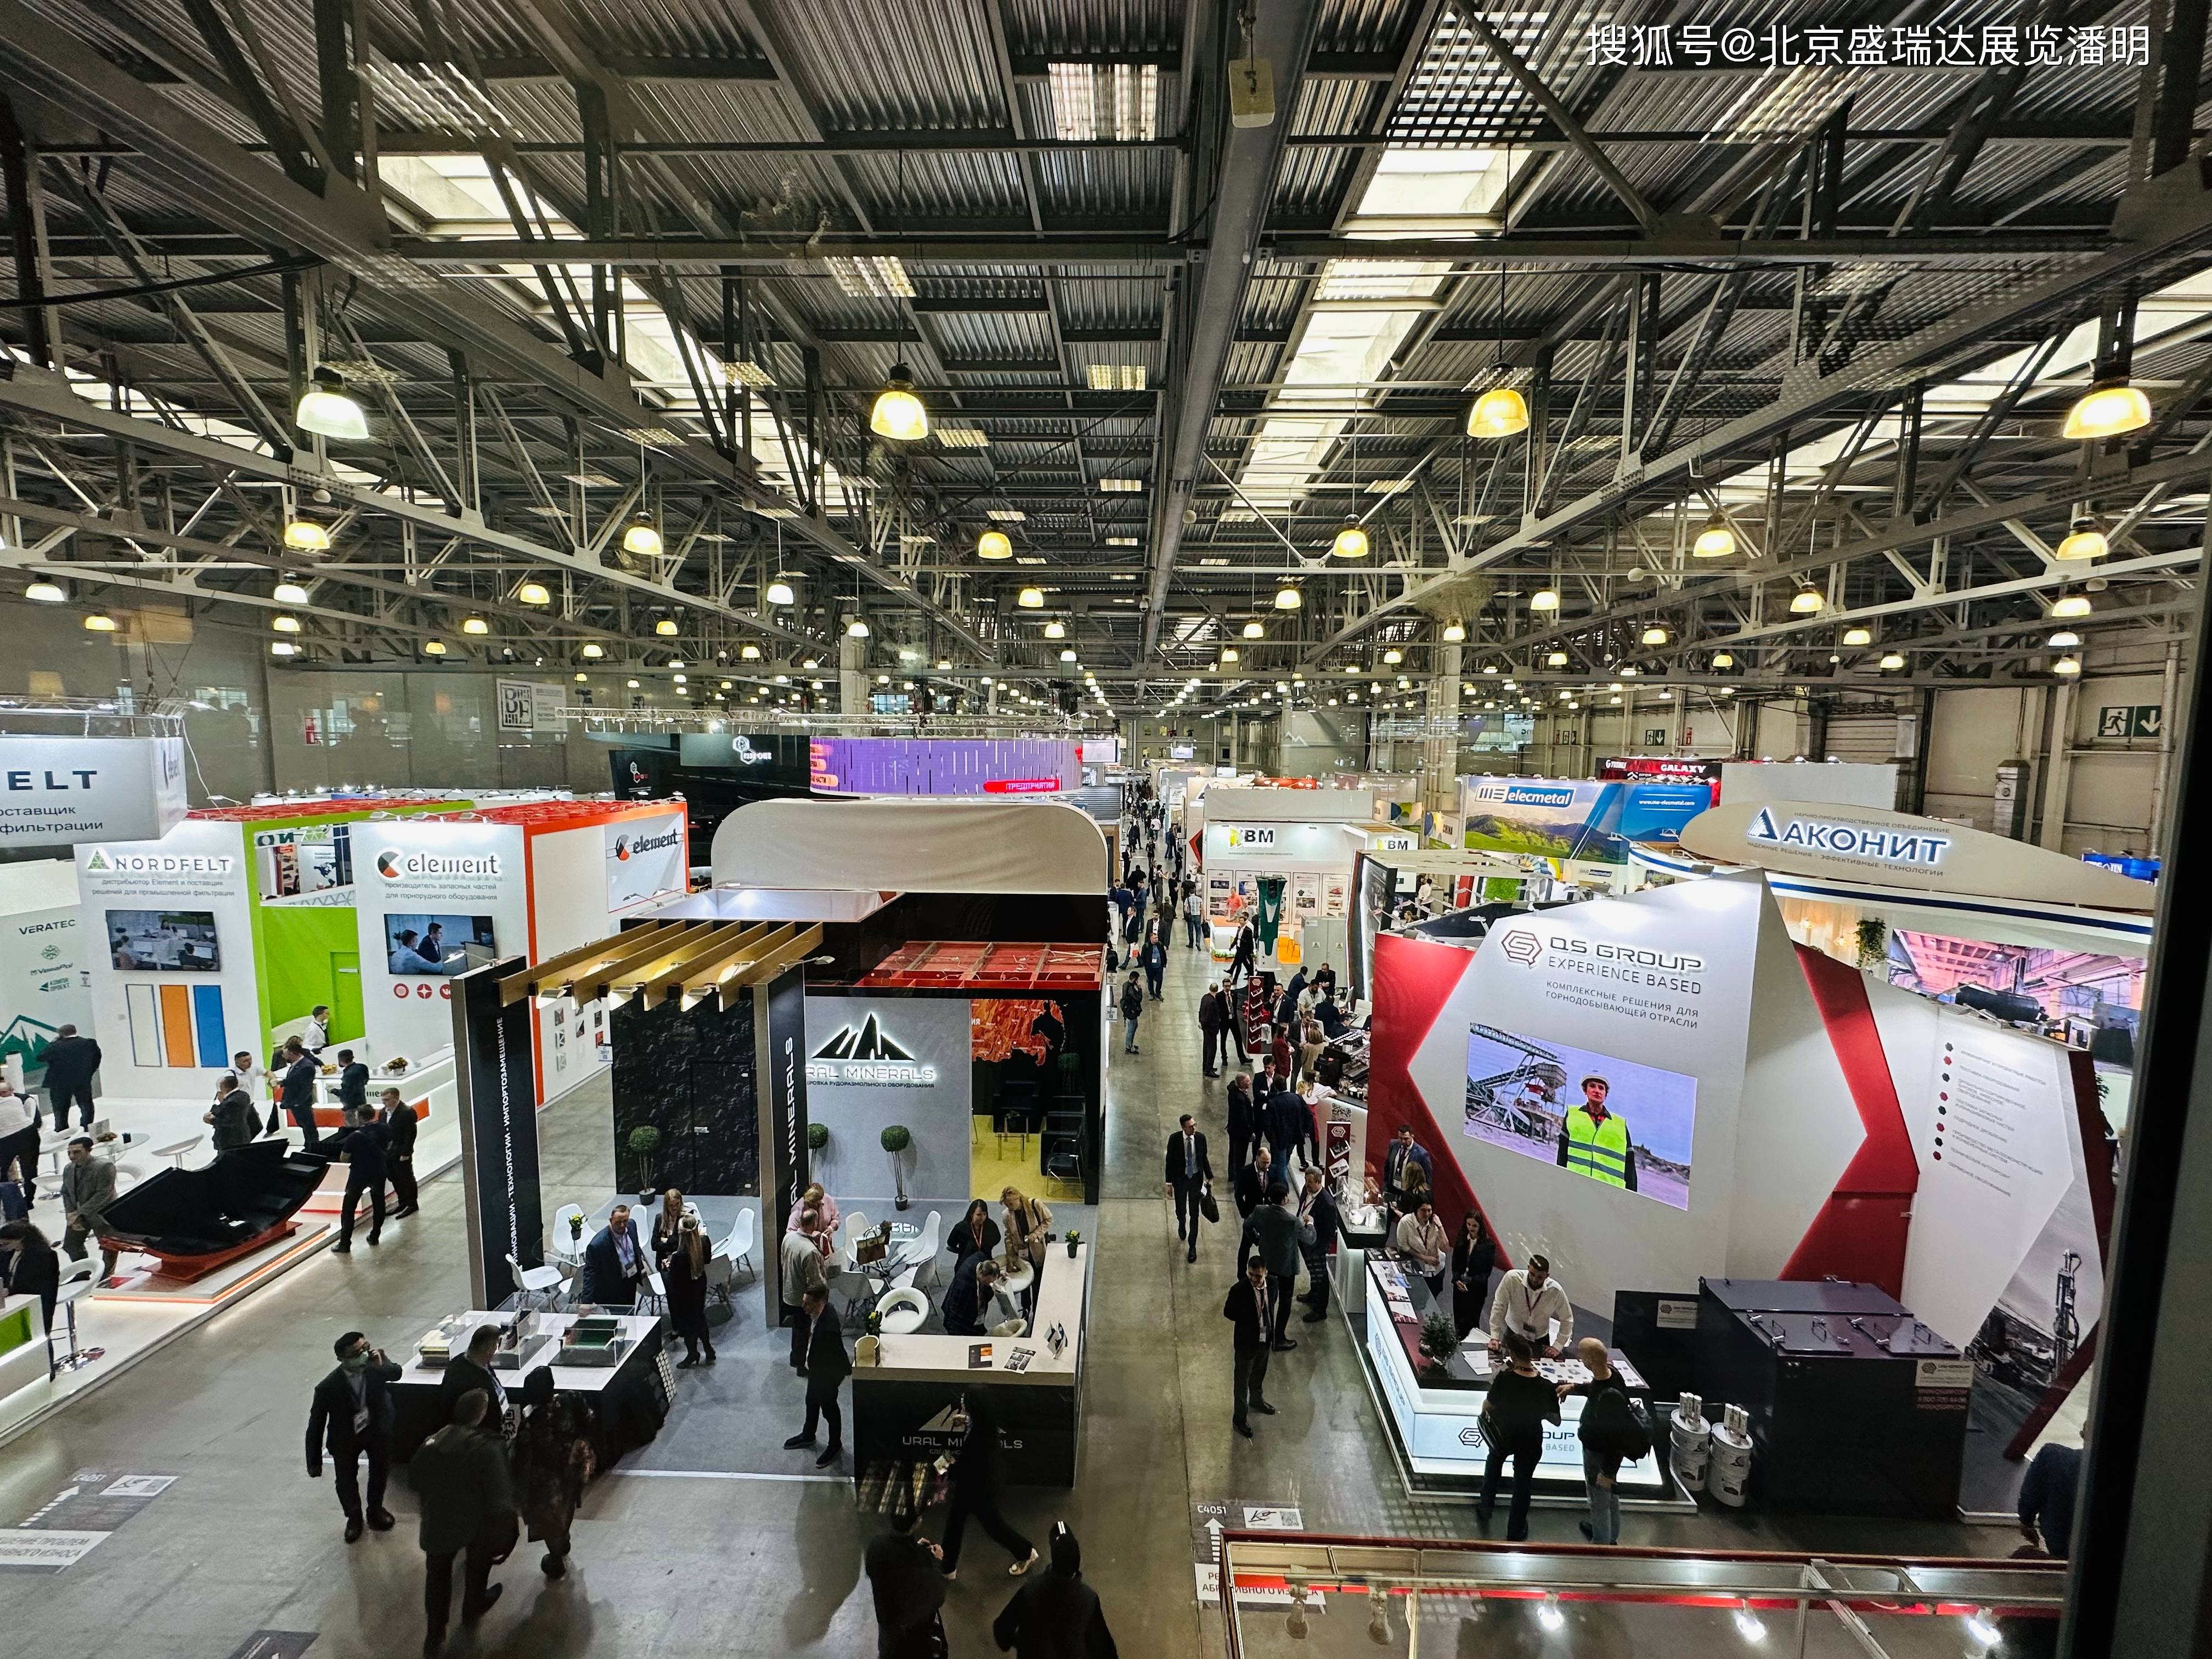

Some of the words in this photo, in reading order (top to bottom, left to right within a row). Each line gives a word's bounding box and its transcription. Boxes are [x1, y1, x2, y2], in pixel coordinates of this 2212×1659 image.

[1661, 764, 1706, 773] GALAXY
[1508, 789, 1571, 805] elecmetal
[0, 822, 103, 834] фильтрации
[1892, 823, 1950, 833] ОБЪЕДИНЕНИЕ
[633, 828, 678, 854] element
[1783, 823, 1947, 862] АКОНИТ
[116, 857, 230, 871] NORDFELT
[408, 854, 498, 874] element
[1820, 854, 1880, 868] ЭФФЕКТИВНЫЕ
[1884, 864, 1944, 877] ТЕХНОЛОГИИ
[19, 919, 76, 935] VERATEC
[1550, 937, 1587, 953] QS
[1596, 944, 1701, 970] GROUP
[1549, 956, 1639, 983] EXPERIENCE
[1647, 974, 1701, 995] BASED
[1547, 981, 1617, 1001] КОМПЛЕКСНЫЕ
[1623, 996, 1671, 1012] РЕШЕНИЯ
[1676, 1007, 1699, 1018] ДЛЯ
[1546, 991, 1646, 1018] ГОРНОДОБЫВАЮЩЕЙ
[1650, 1013, 1697, 1029] ОТРАСЛИ
[496, 1017, 510, 1127] ИМПОРТОЗАМЕЩЕНИЕ
[806, 1066, 839, 1077] RAL
[847, 1066, 934, 1080] MINERALS
[785, 1036, 797, 1166] MINERALS
[504, 1132, 514, 1198] ТЕХНОЛОГИИ
[902, 1436, 942, 1446] URAL
[1542, 1431, 1575, 1440] OUP
[1545, 1443, 1575, 1452] BASED
[1197, 1505, 1227, 1515] C4051
[39, 1537, 90, 1546] ПРОБЛЕМ
